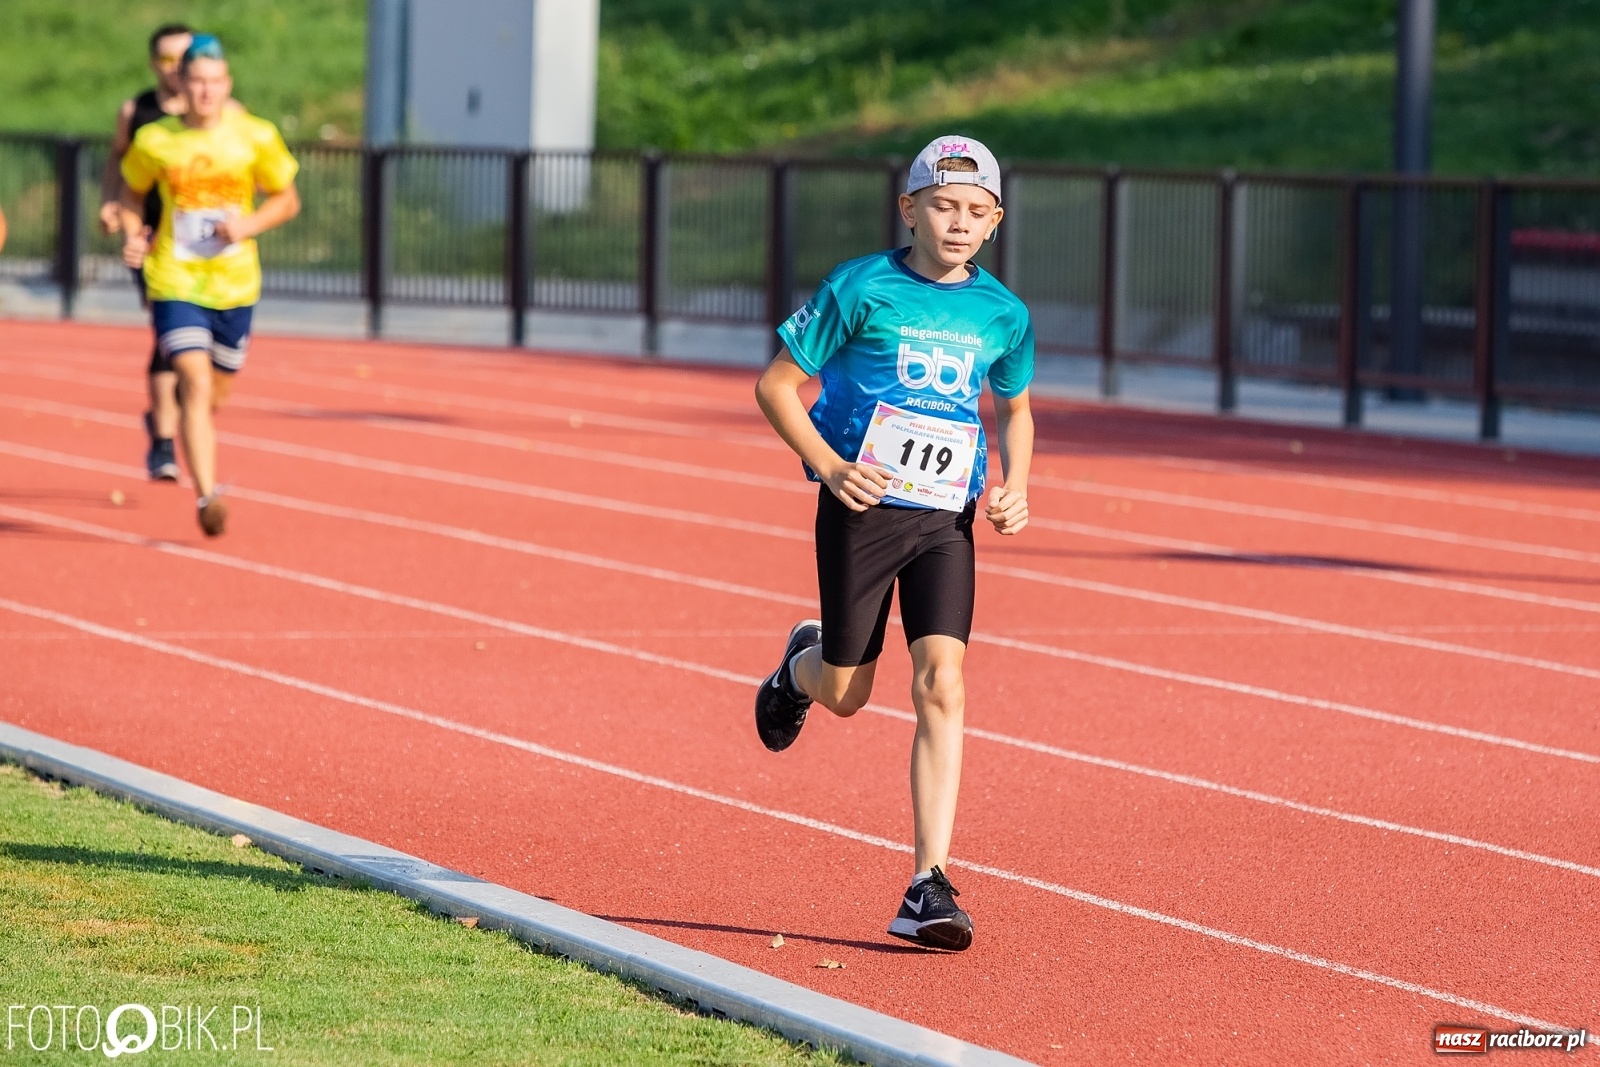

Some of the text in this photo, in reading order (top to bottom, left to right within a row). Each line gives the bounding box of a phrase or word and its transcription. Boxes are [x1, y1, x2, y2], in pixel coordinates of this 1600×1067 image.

[900, 325, 982, 348] BiegamBoLubię
[896, 343, 975, 397] bbl
[905, 396, 957, 413] RACIBÓRZ
[900, 438, 953, 476] 119
